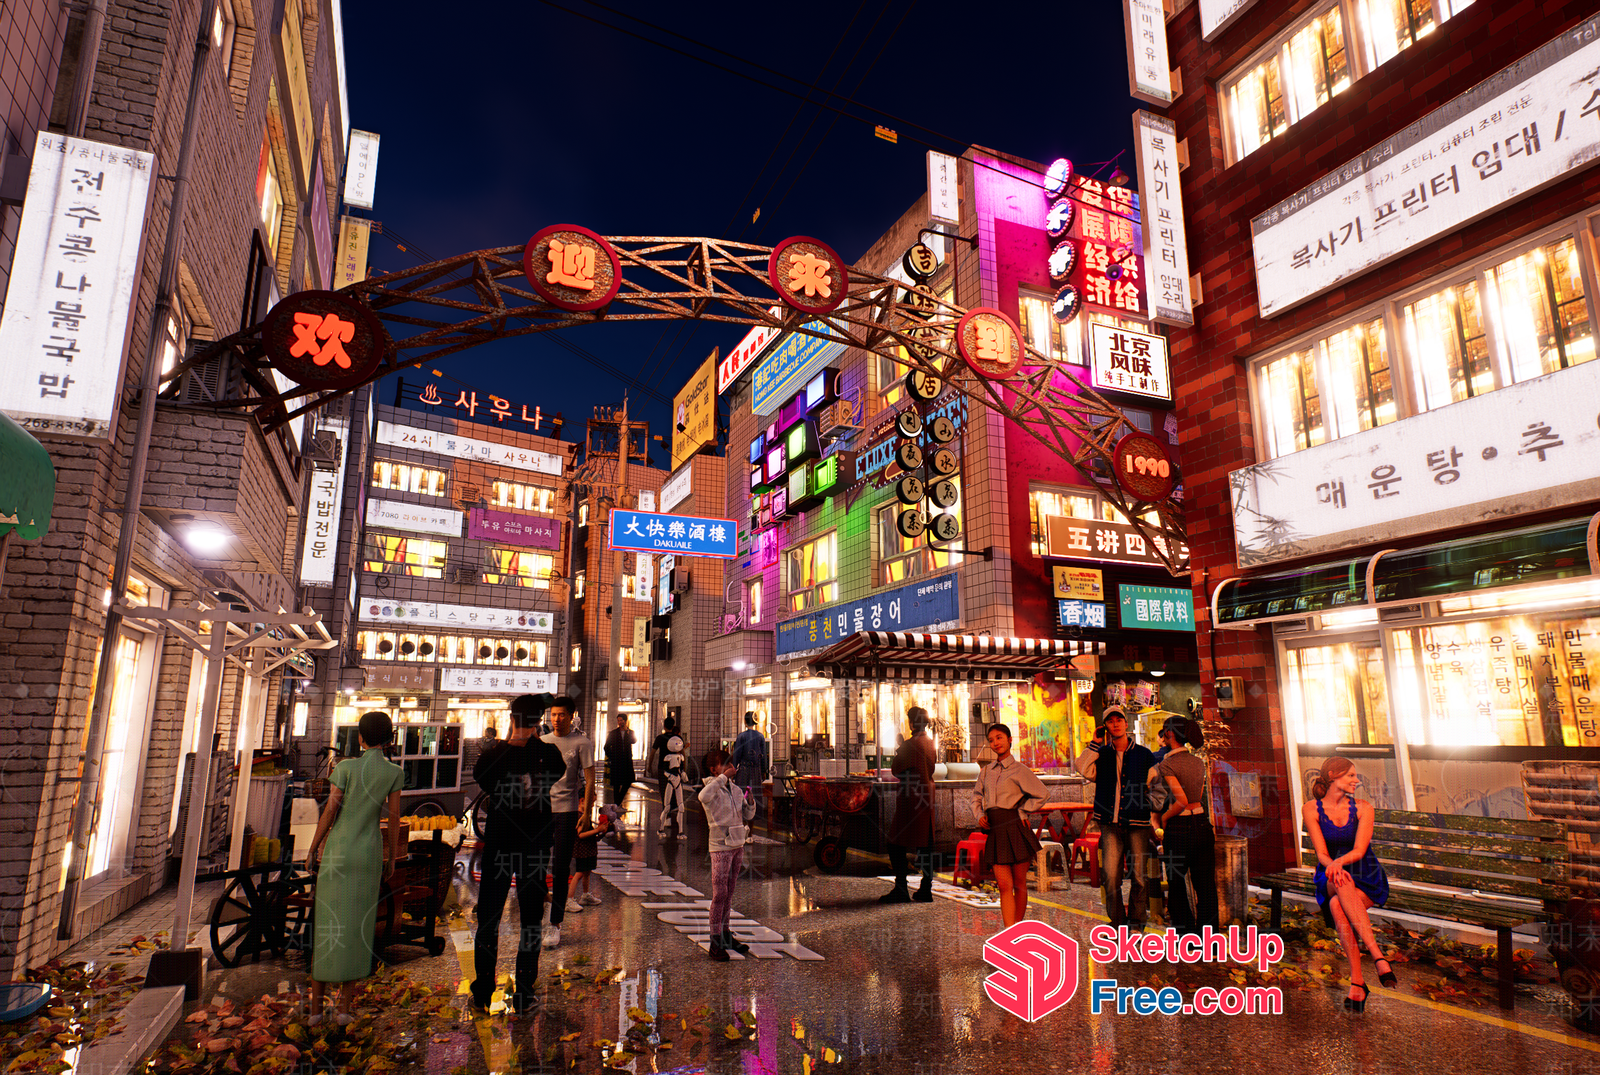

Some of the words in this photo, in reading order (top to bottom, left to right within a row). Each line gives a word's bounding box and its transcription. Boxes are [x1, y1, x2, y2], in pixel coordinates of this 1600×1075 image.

[1263, 209, 1280, 227] 각종
[1372, 144, 1394, 163] 수리
[1290, 216, 1363, 270] 복사기
[1373, 164, 1461, 231] 프린터
[1471, 121, 1542, 181] 임대
[1080, 175, 1111, 307] 发展经济
[1106, 185, 1140, 312] 保障供给
[289, 311, 356, 369] 欢
[546, 238, 596, 292] 迎
[788, 252, 832, 299] 来
[973, 319, 1012, 365] 到
[1125, 454, 1171, 479] 1990
[1109, 332, 1152, 359] 北京
[1103, 369, 1160, 393] 纯手工制作
[1110, 351, 1153, 377] 风味
[685, 374, 710, 409] GoldStar
[454, 390, 544, 431] 사우나
[401, 432, 433, 448] 24시
[503, 451, 542, 468] 사우나
[1315, 445, 1464, 510] 매운탕
[524, 525, 552, 538] 마사지
[623, 515, 727, 544] 大快樂酒樓
[653, 538, 692, 550] DAKUAILE
[1062, 600, 1105, 628] 香烟
[1135, 598, 1189, 624] 國際飲料
[1446, 640, 1465, 676] 수육
[1489, 635, 1513, 695] 우족탕
[1512, 633, 1540, 715] 갈매기살
[1564, 628, 1598, 738] 민물매운탕
